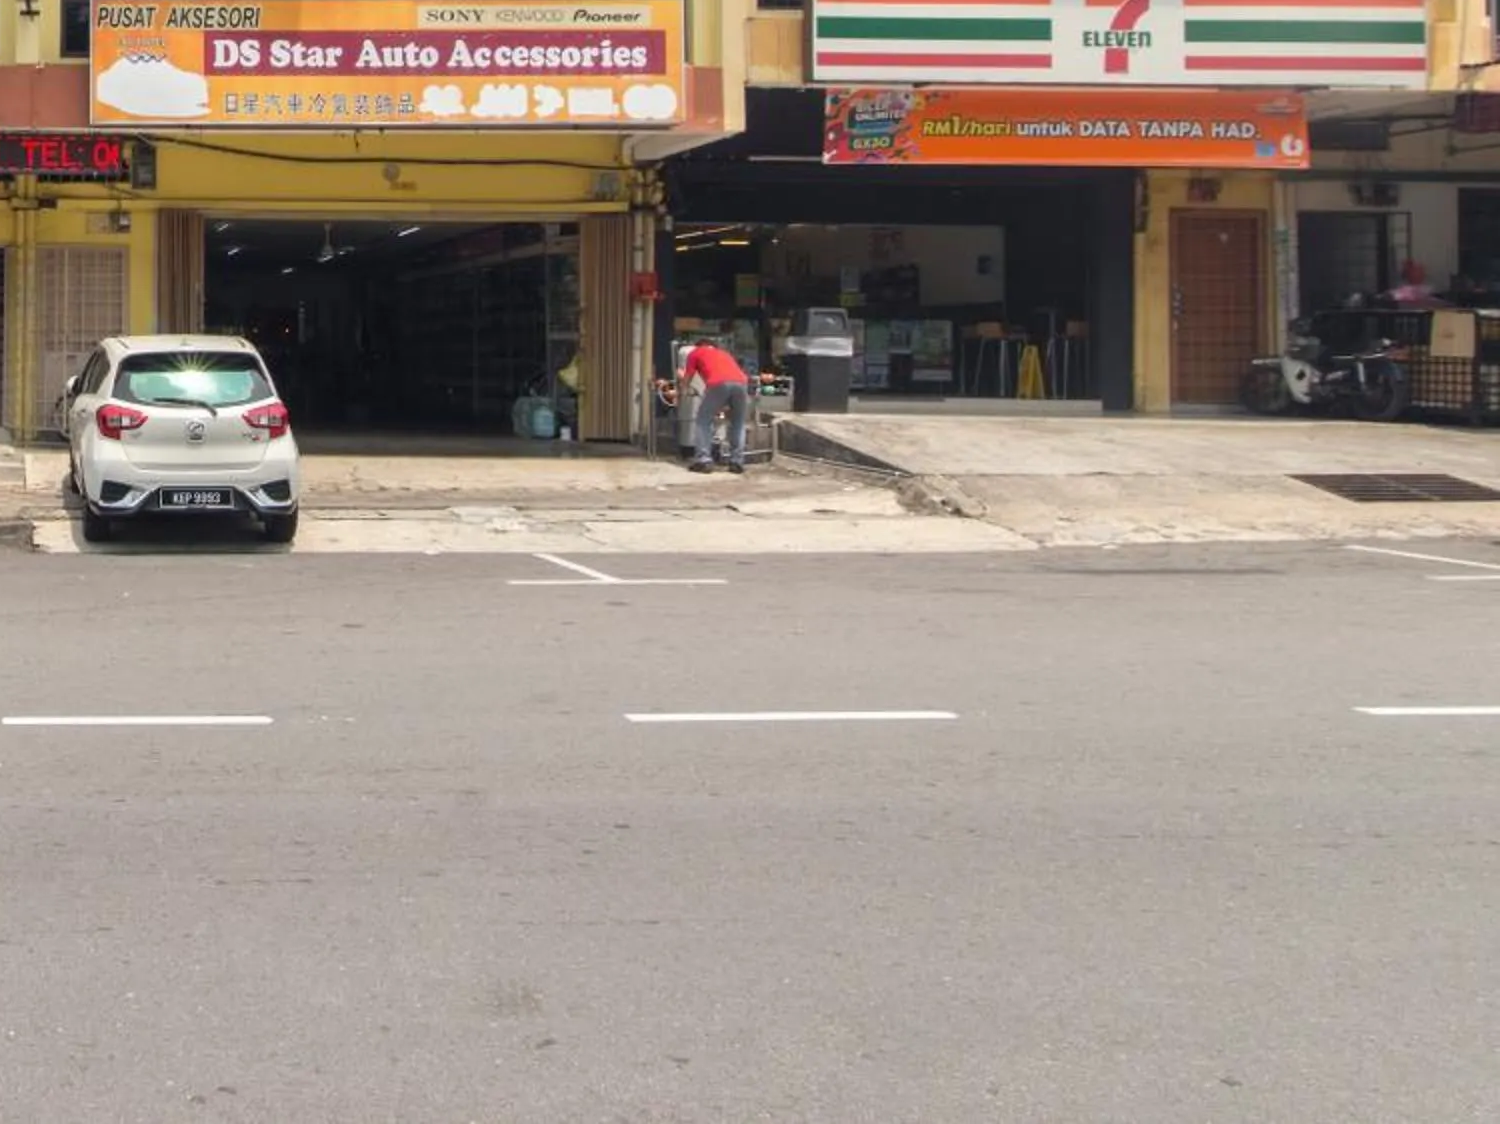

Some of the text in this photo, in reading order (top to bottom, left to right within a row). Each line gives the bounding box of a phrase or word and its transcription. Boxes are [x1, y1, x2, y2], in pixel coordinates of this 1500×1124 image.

[97, 6, 261, 29] PUSAT AKSESORI
[425, 8, 642, 23] SONY KENWOOD Pioneer
[213, 38, 648, 69] DS Star Auto Accessories
[1016, 121, 1073, 137] untuk
[1079, 121, 1131, 137] DATA
[1137, 121, 1204, 137] TANPA
[1210, 121, 1262, 139] HAD.
